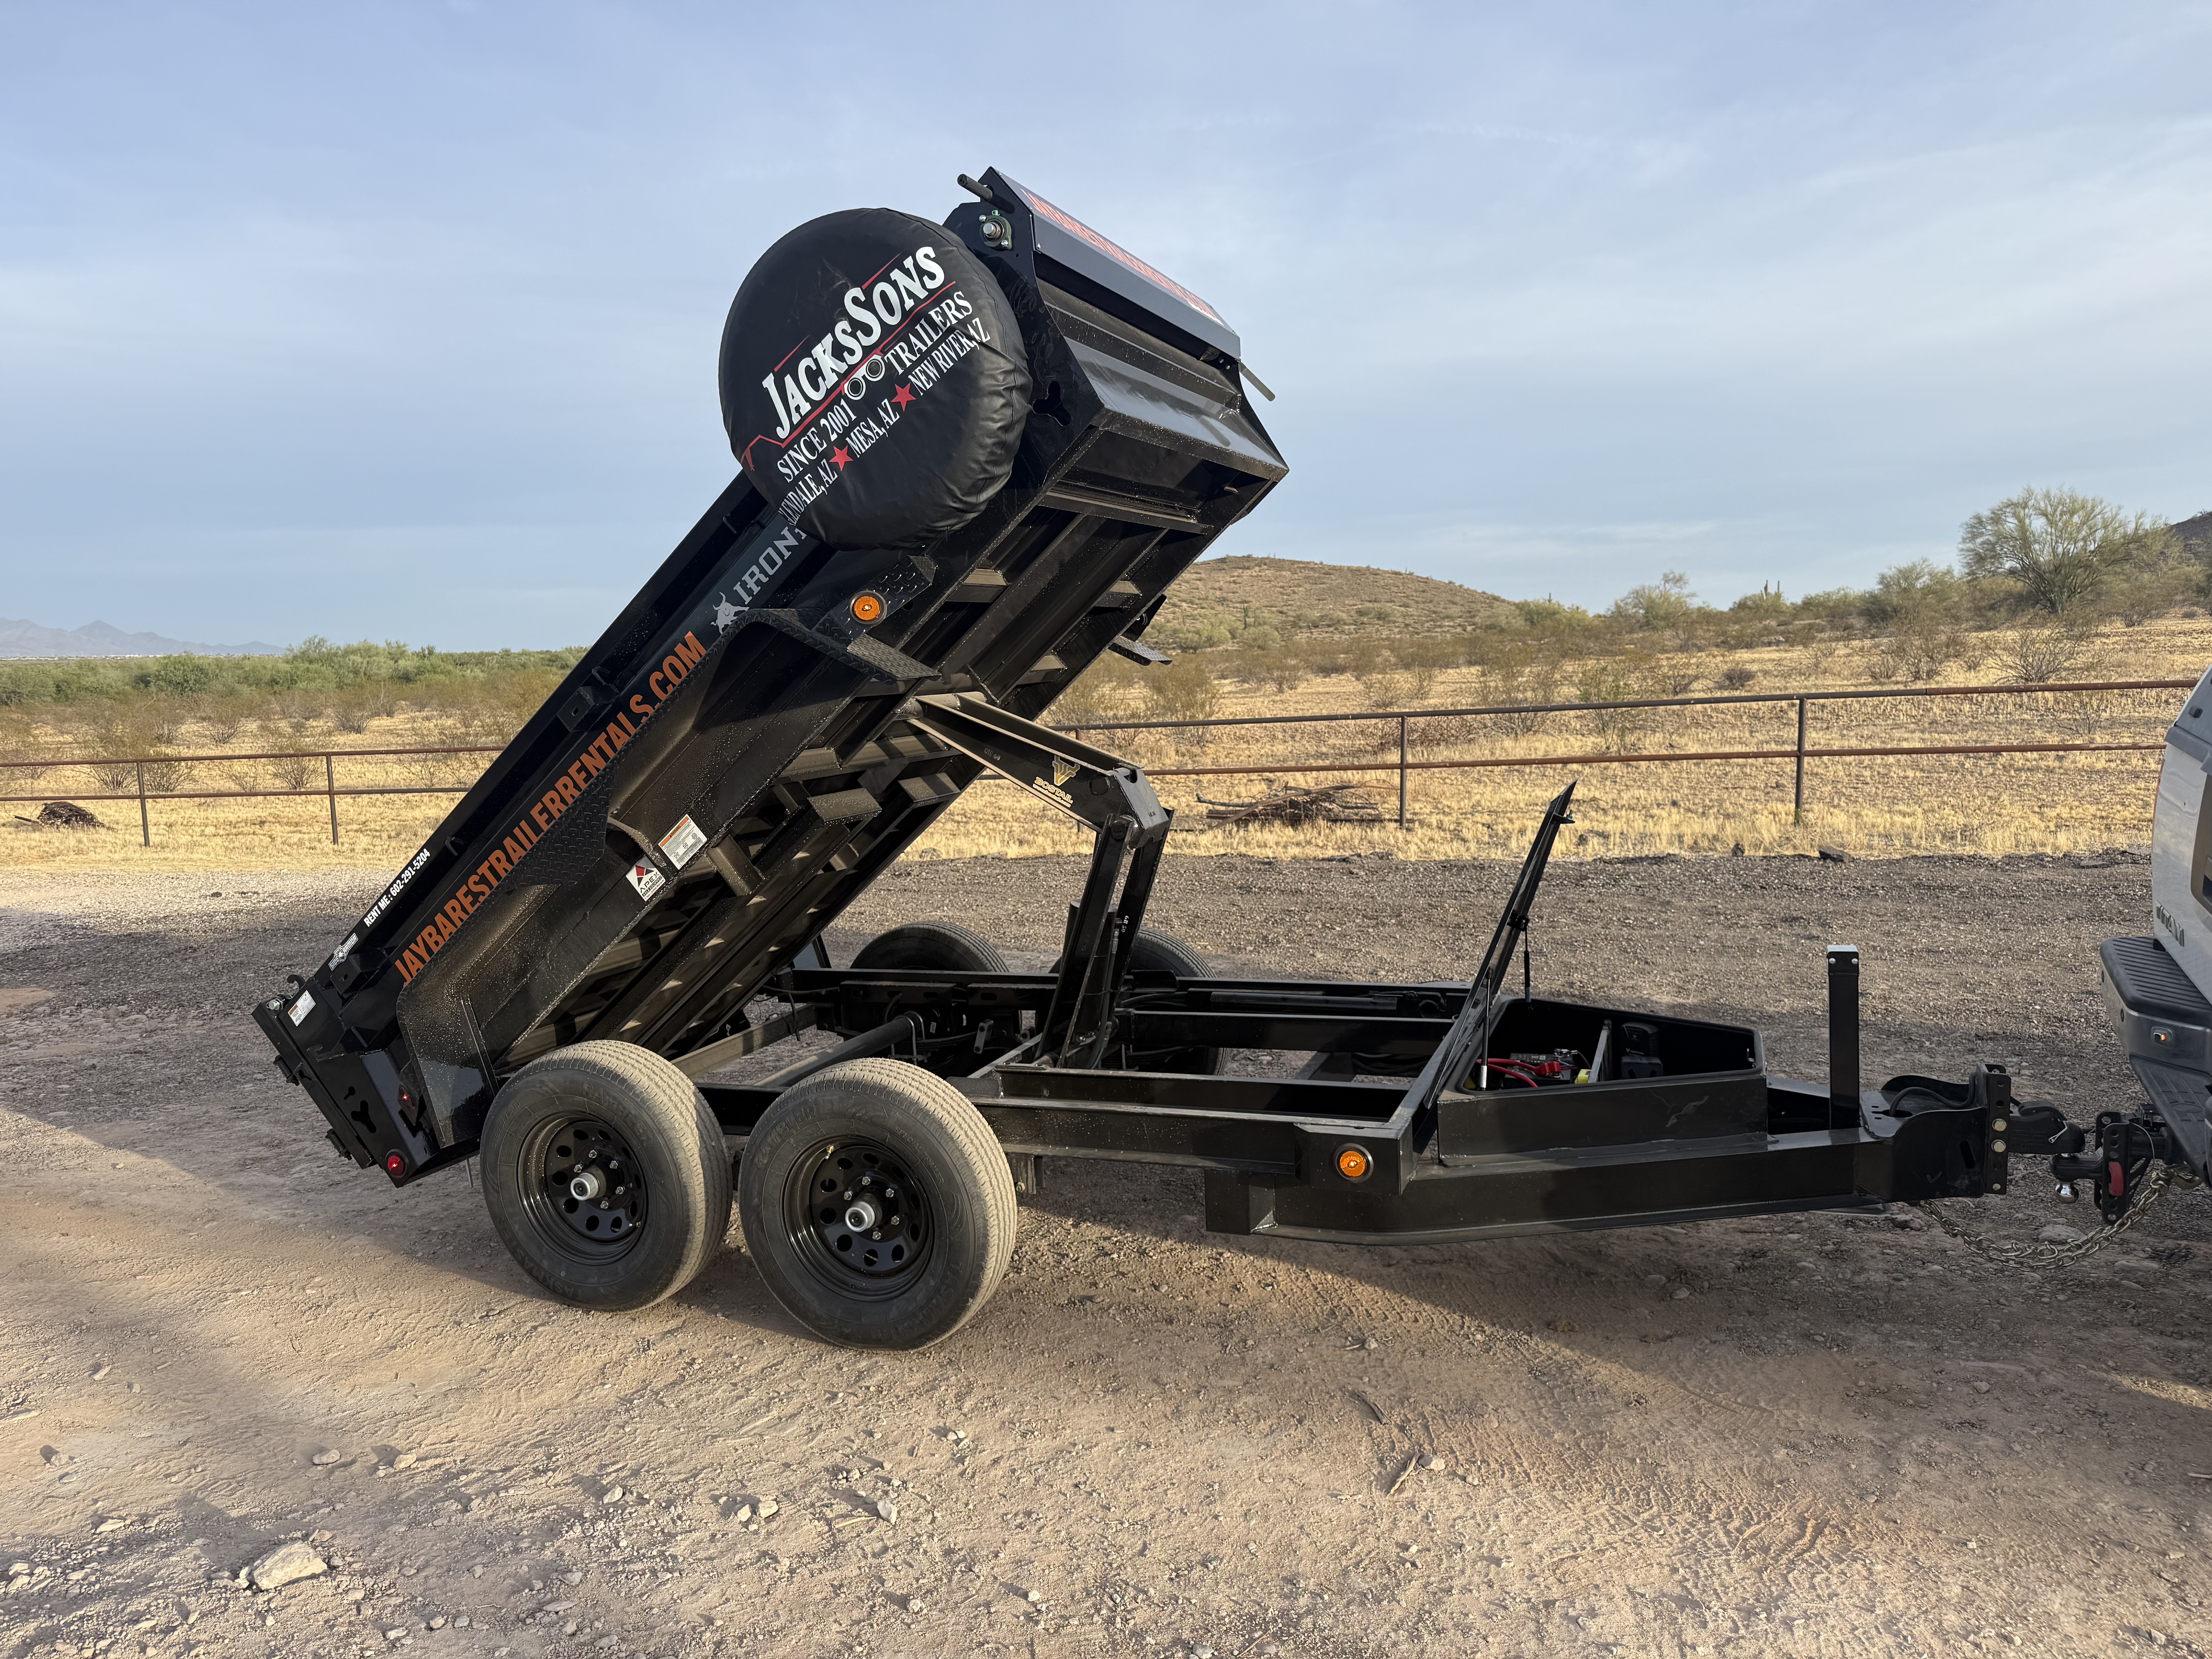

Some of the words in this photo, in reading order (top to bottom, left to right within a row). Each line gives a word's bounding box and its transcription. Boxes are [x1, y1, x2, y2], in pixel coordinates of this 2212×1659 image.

[884, 291, 972, 375] TRAILERS
[908, 357, 940, 396] NEW
[777, 427, 827, 483] SINCE
[820, 398, 857, 442] 2001
[845, 417, 888, 458] MESA,
[877, 398, 900, 429] AZ
[817, 459, 838, 487] AZ
[394, 630, 707, 988] JAYBARESTRAILERRENTALS.COM
[1034, 776, 1073, 804] BOSTAIL
[364, 905, 381, 927] RENT
[378, 894, 393, 910] ME:
[390, 848, 430, 896] 602-291-5204
[640, 872, 660, 893] APEX
[330, 956, 340, 969] SIDE
[342, 935, 357, 953] ARMOR
[754, 1105, 819, 1170] RAMBLER
